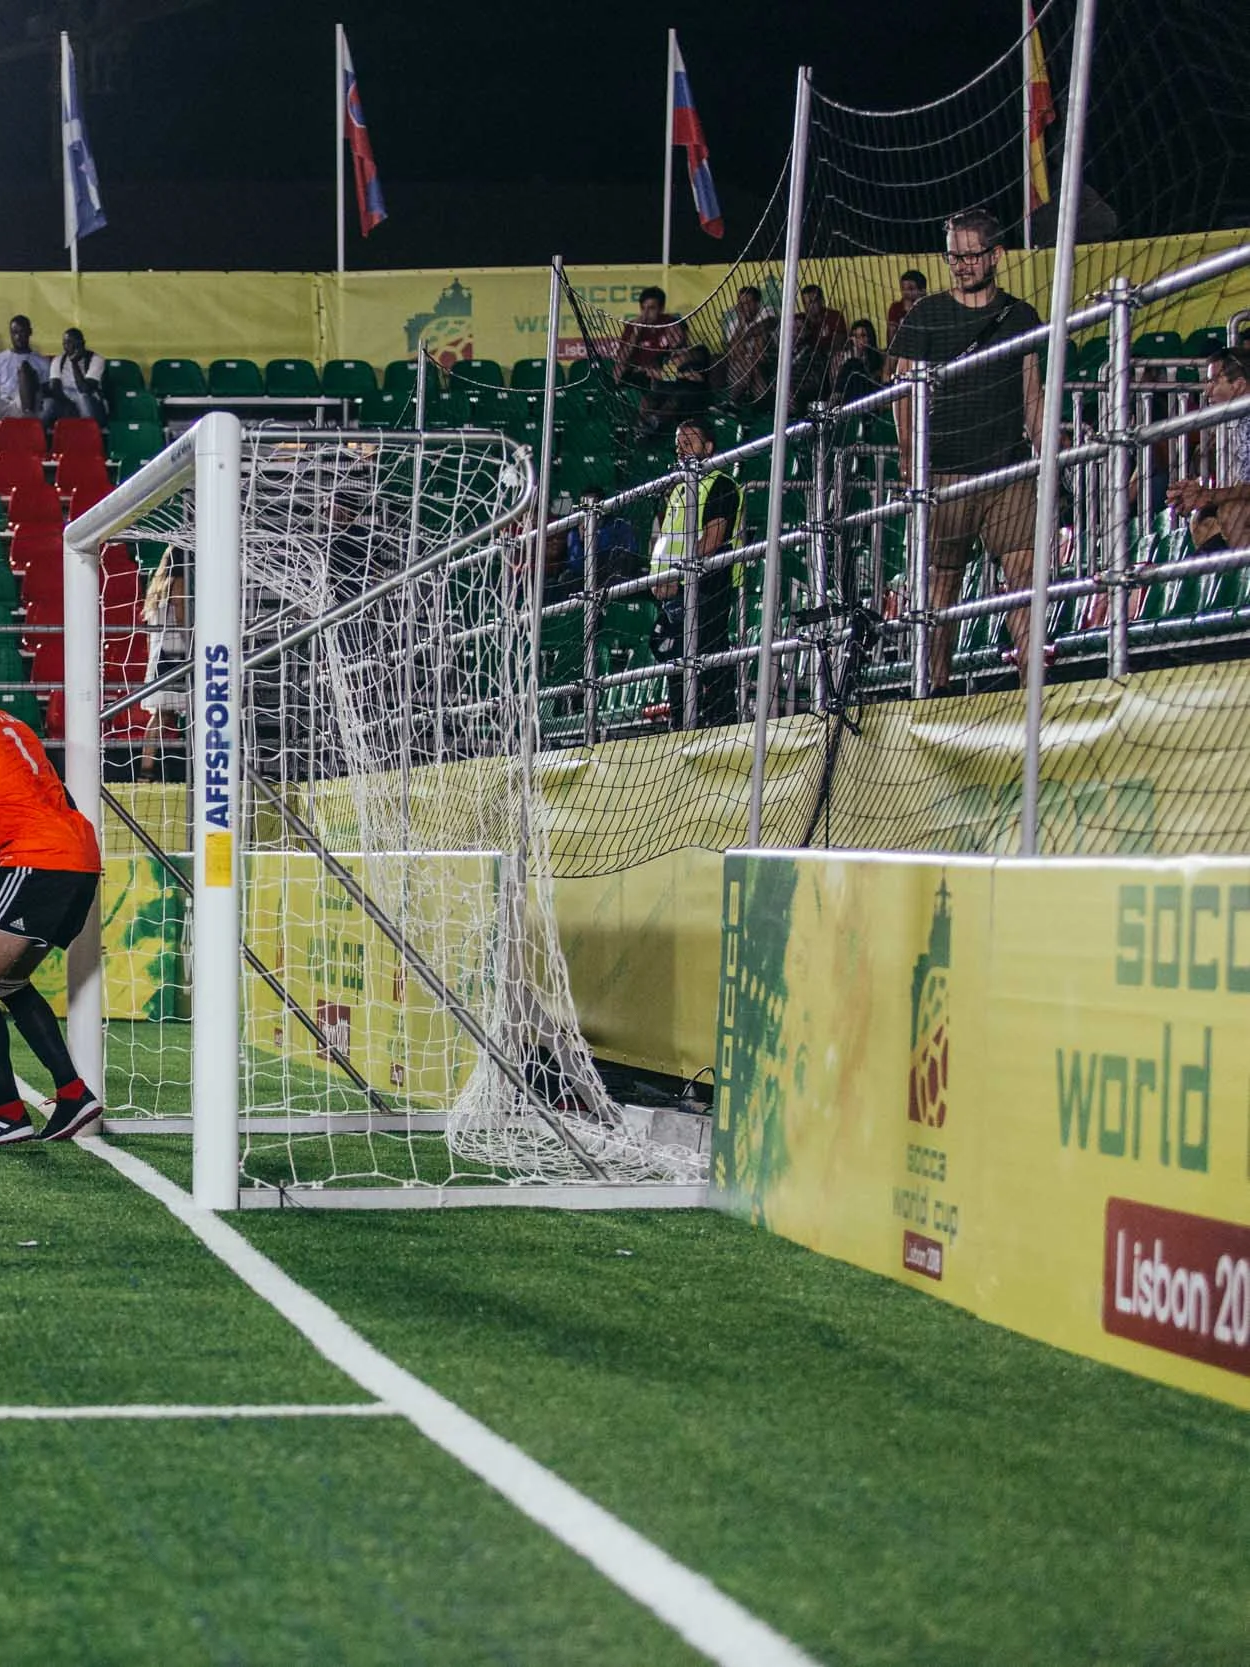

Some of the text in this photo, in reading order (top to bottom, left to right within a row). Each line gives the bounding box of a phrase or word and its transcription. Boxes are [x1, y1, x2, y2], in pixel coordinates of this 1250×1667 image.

[2, 727, 38, 776] 1
[205, 644, 230, 830] AFFSPORTS
[1055, 1021, 1213, 1174] world
[907, 1143, 947, 1183] socca
[933, 1199, 959, 1246] cup
[1115, 1228, 1210, 1338] Lisbon
